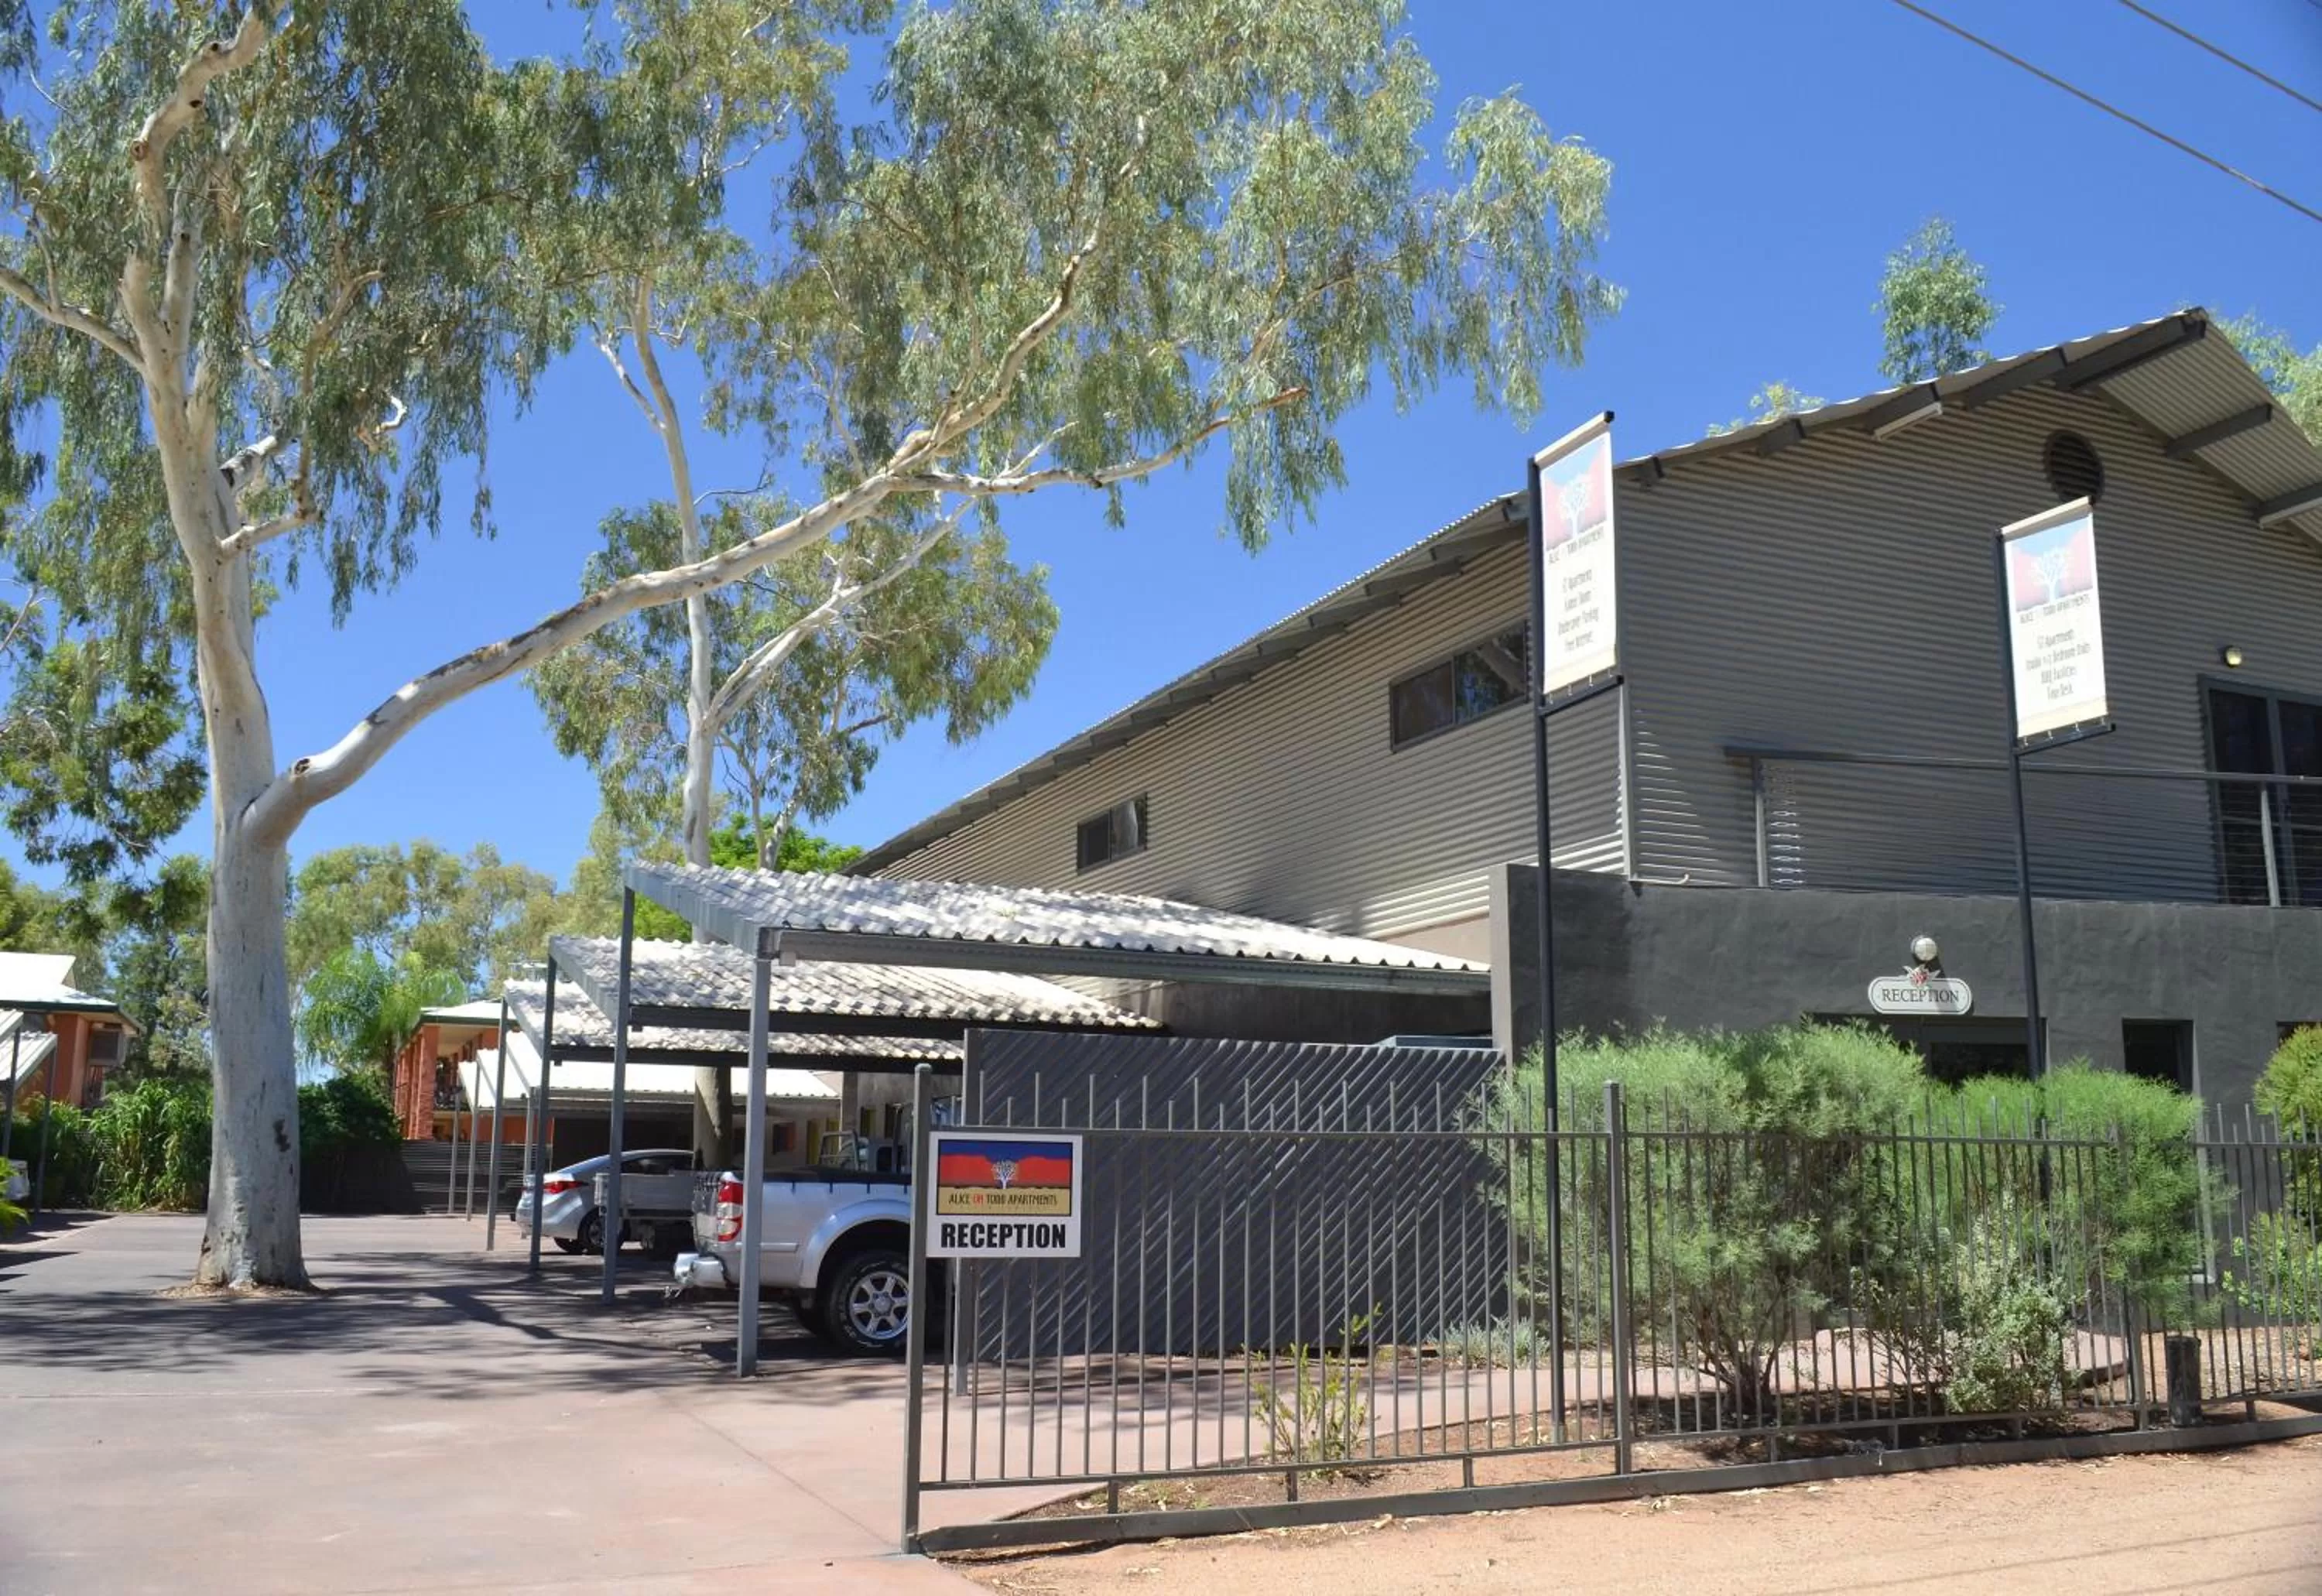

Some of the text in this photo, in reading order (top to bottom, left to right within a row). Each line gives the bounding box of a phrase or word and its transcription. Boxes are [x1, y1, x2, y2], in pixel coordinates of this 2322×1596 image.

[1882, 988, 1960, 1002] RECEPTION
[948, 1193, 970, 1205] ALICE
[987, 1194, 1005, 1205] TODD
[1007, 1194, 1058, 1206] APARTMENTS
[940, 1222, 1066, 1248] RECEPTION
